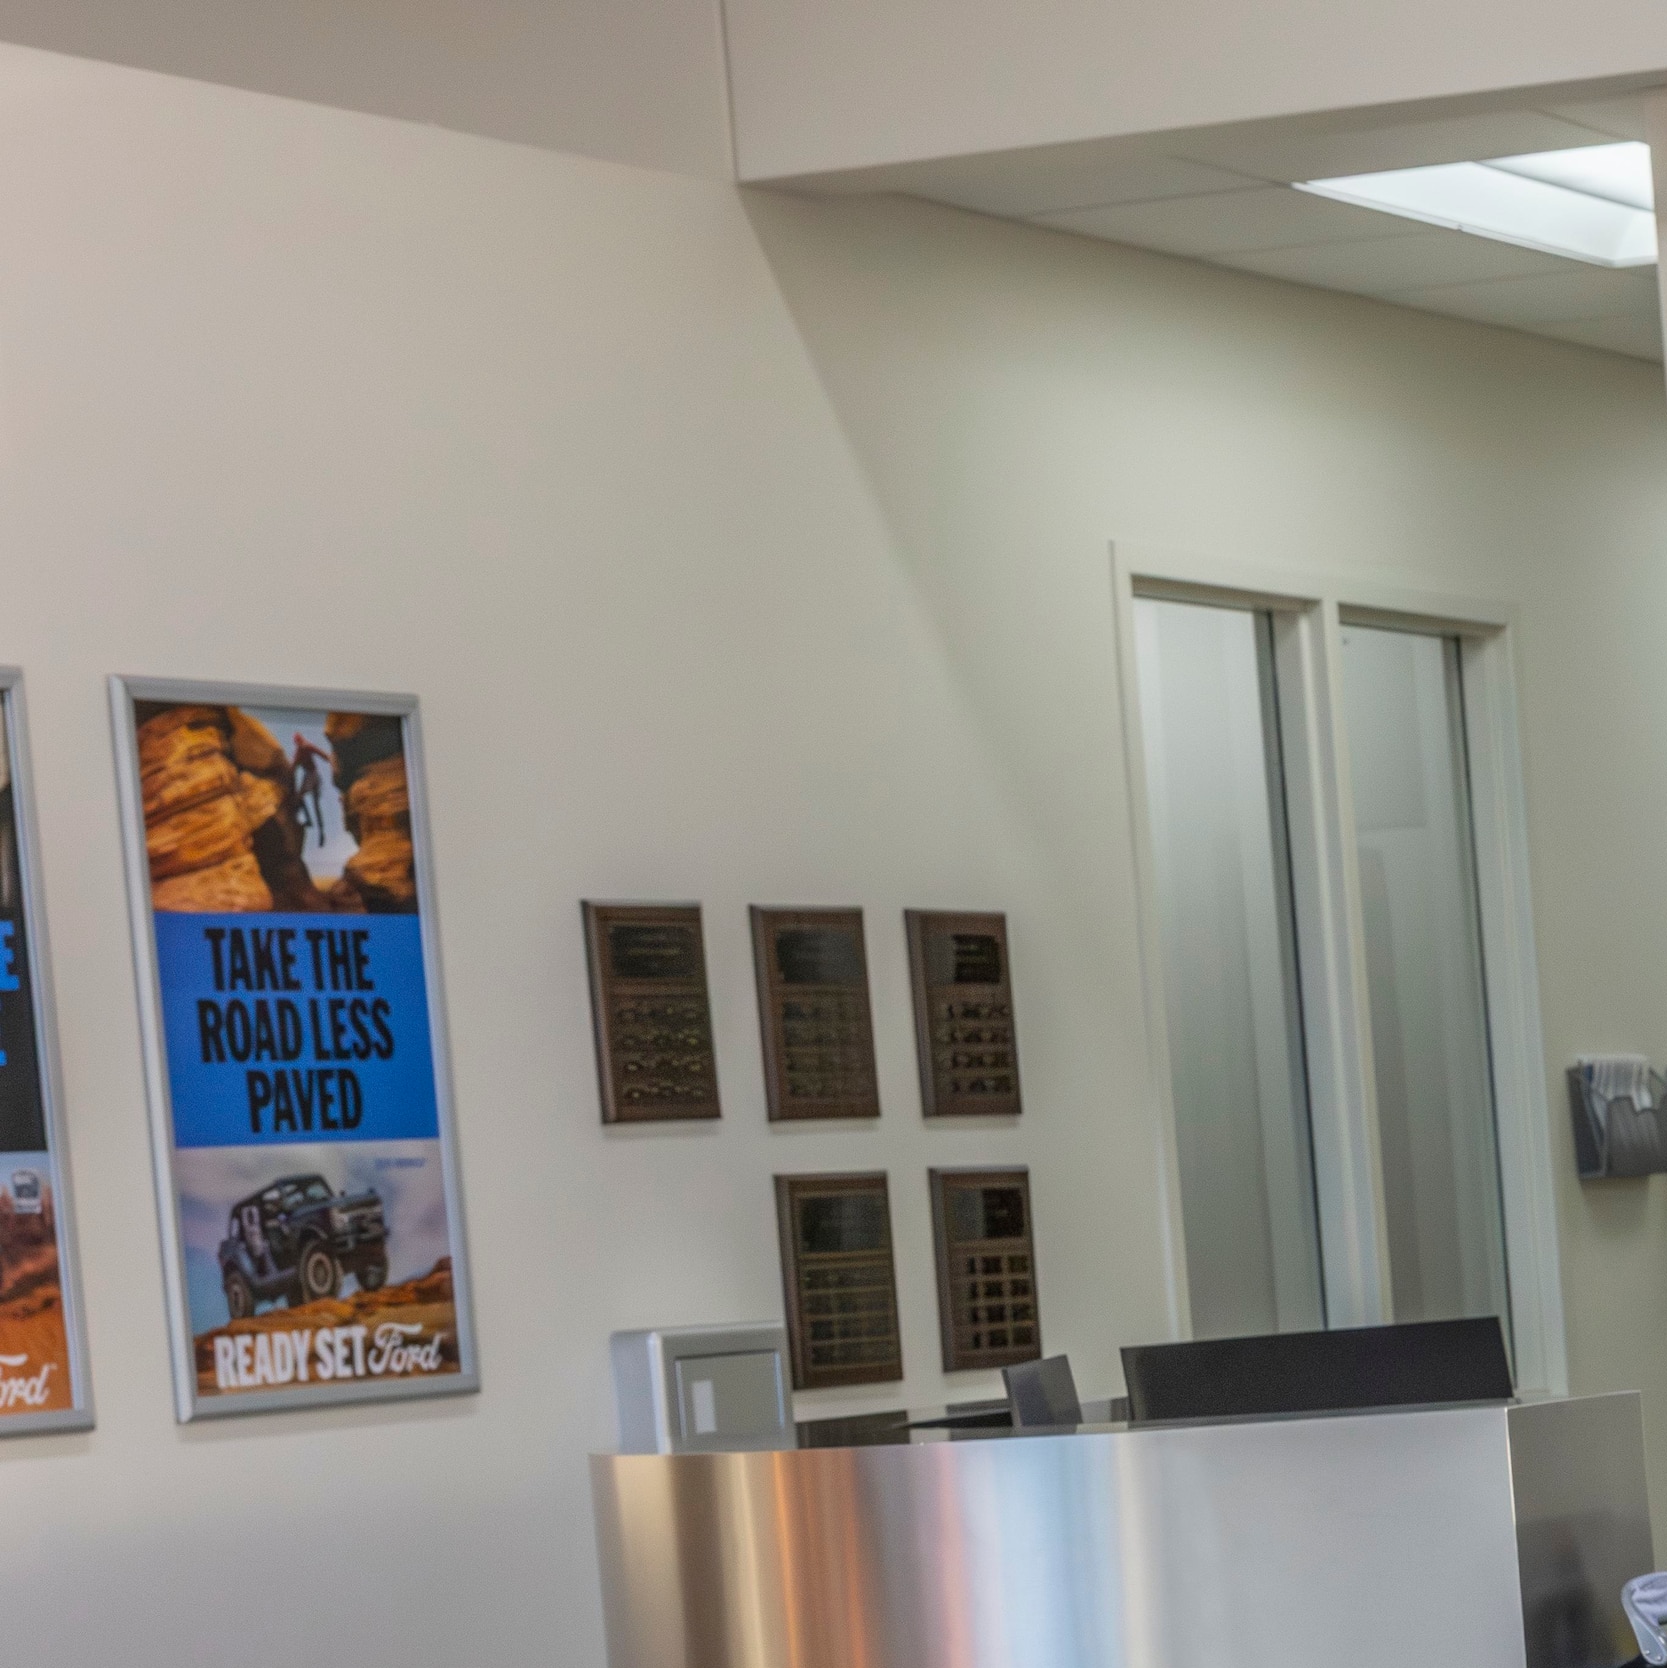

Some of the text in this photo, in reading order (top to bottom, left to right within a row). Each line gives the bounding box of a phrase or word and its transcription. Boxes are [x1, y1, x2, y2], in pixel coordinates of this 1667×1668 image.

[204, 927, 374, 991] TAKE THE
[197, 997, 394, 1063] ROAD LESS
[246, 1067, 363, 1134] PAVED
[0, 1352, 50, 1408] ord
[213, 1321, 443, 1389] READY SET Ford
